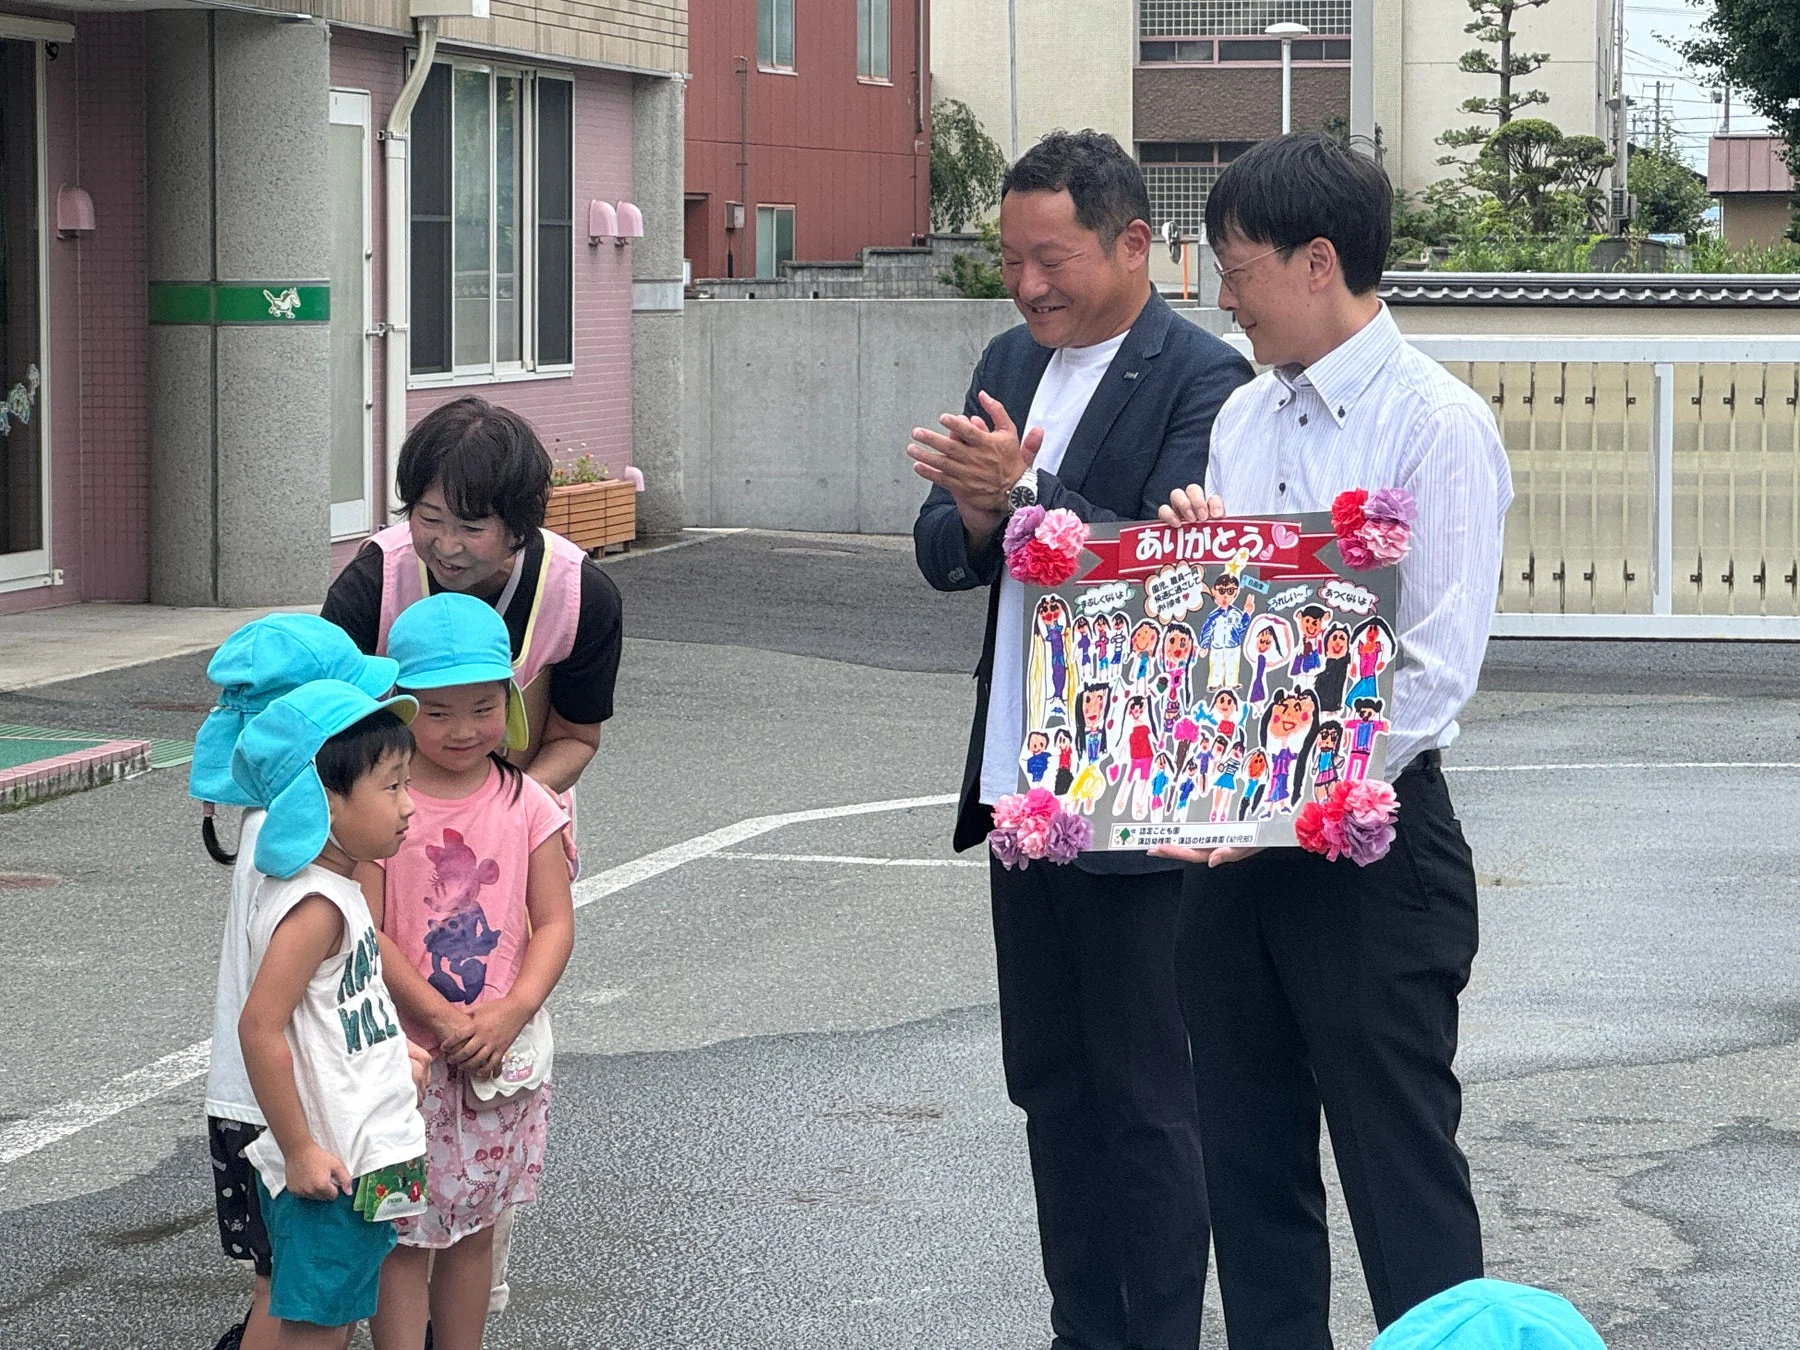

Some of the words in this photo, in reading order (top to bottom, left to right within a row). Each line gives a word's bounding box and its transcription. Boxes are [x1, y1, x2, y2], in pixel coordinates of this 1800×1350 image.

[1135, 525, 1264, 560] ありがとう
